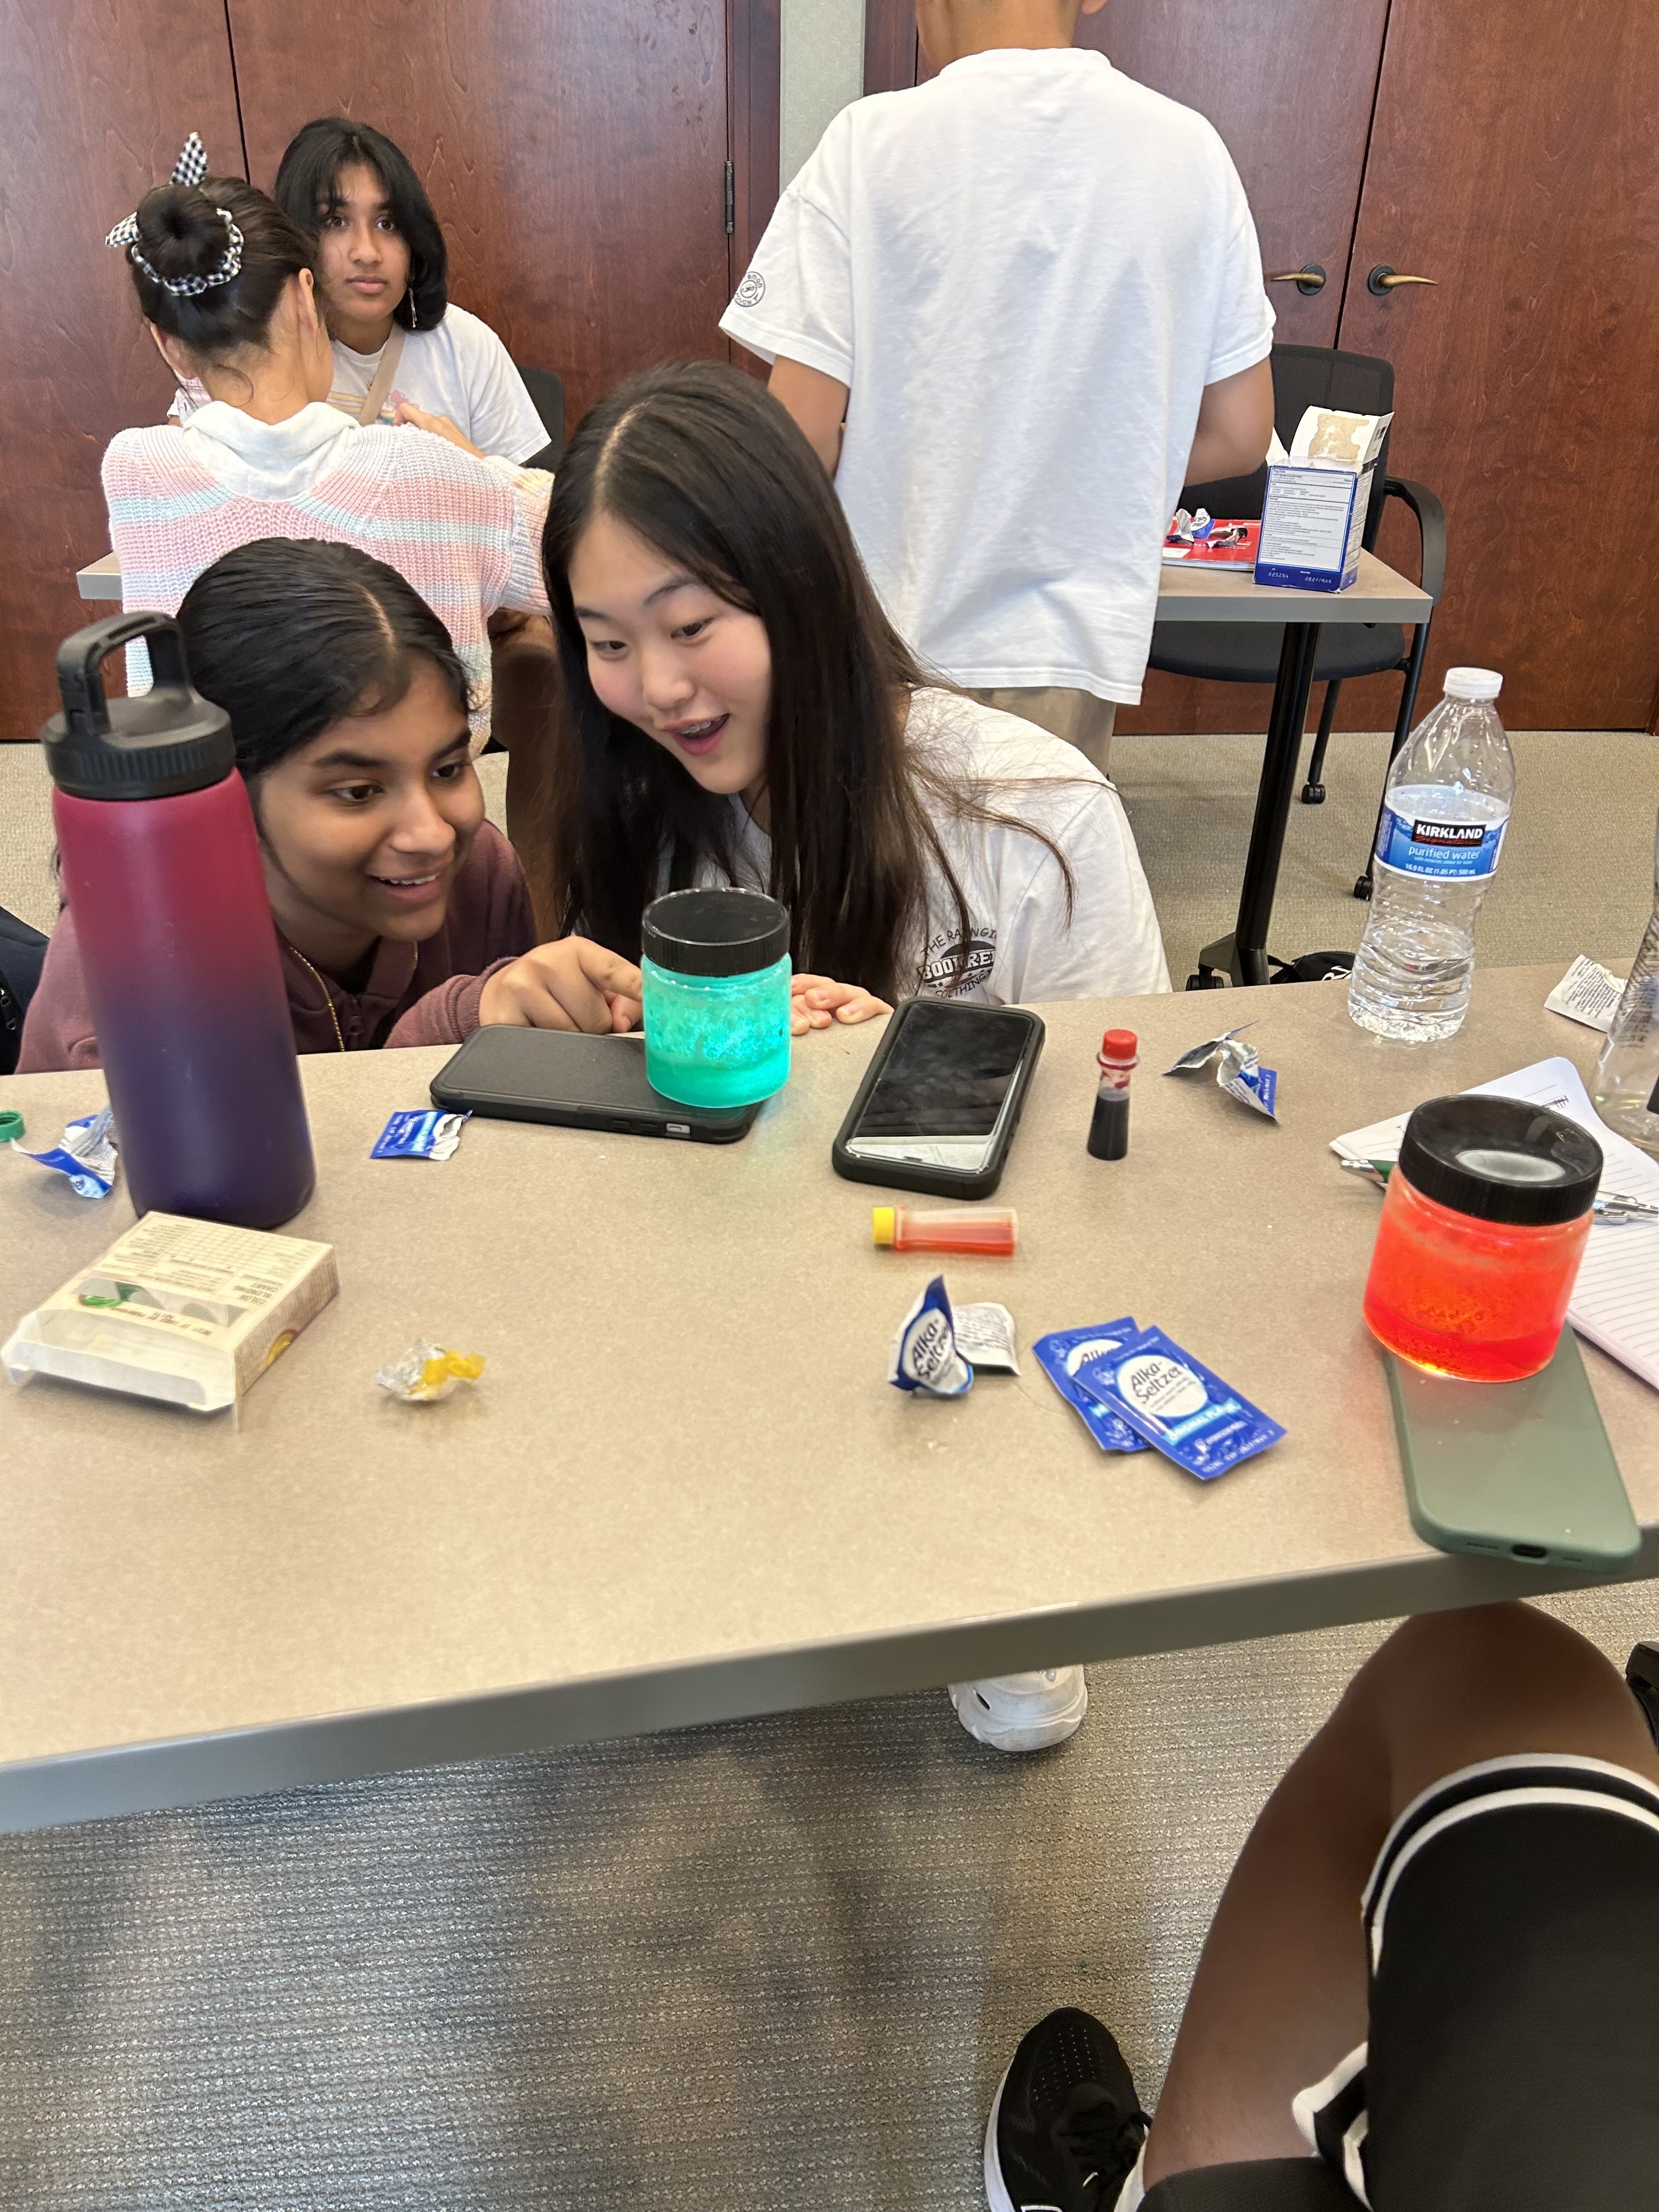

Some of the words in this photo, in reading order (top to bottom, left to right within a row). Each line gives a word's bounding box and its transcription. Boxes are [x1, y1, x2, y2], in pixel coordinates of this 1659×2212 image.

[1416, 823, 1483, 839] KIRKLAND
[1408, 847, 1450, 860] purified
[1452, 850, 1481, 860] water
[921, 935, 946, 956] THE
[233, 1285, 273, 1299] BLENDING
[250, 1282, 279, 1293] CHART
[240, 1294, 267, 1305] COLOR
[912, 1318, 940, 1370] Alka-
[1131, 1362, 1163, 1391] Alka-
[1135, 1367, 1183, 1404] Seltzer
